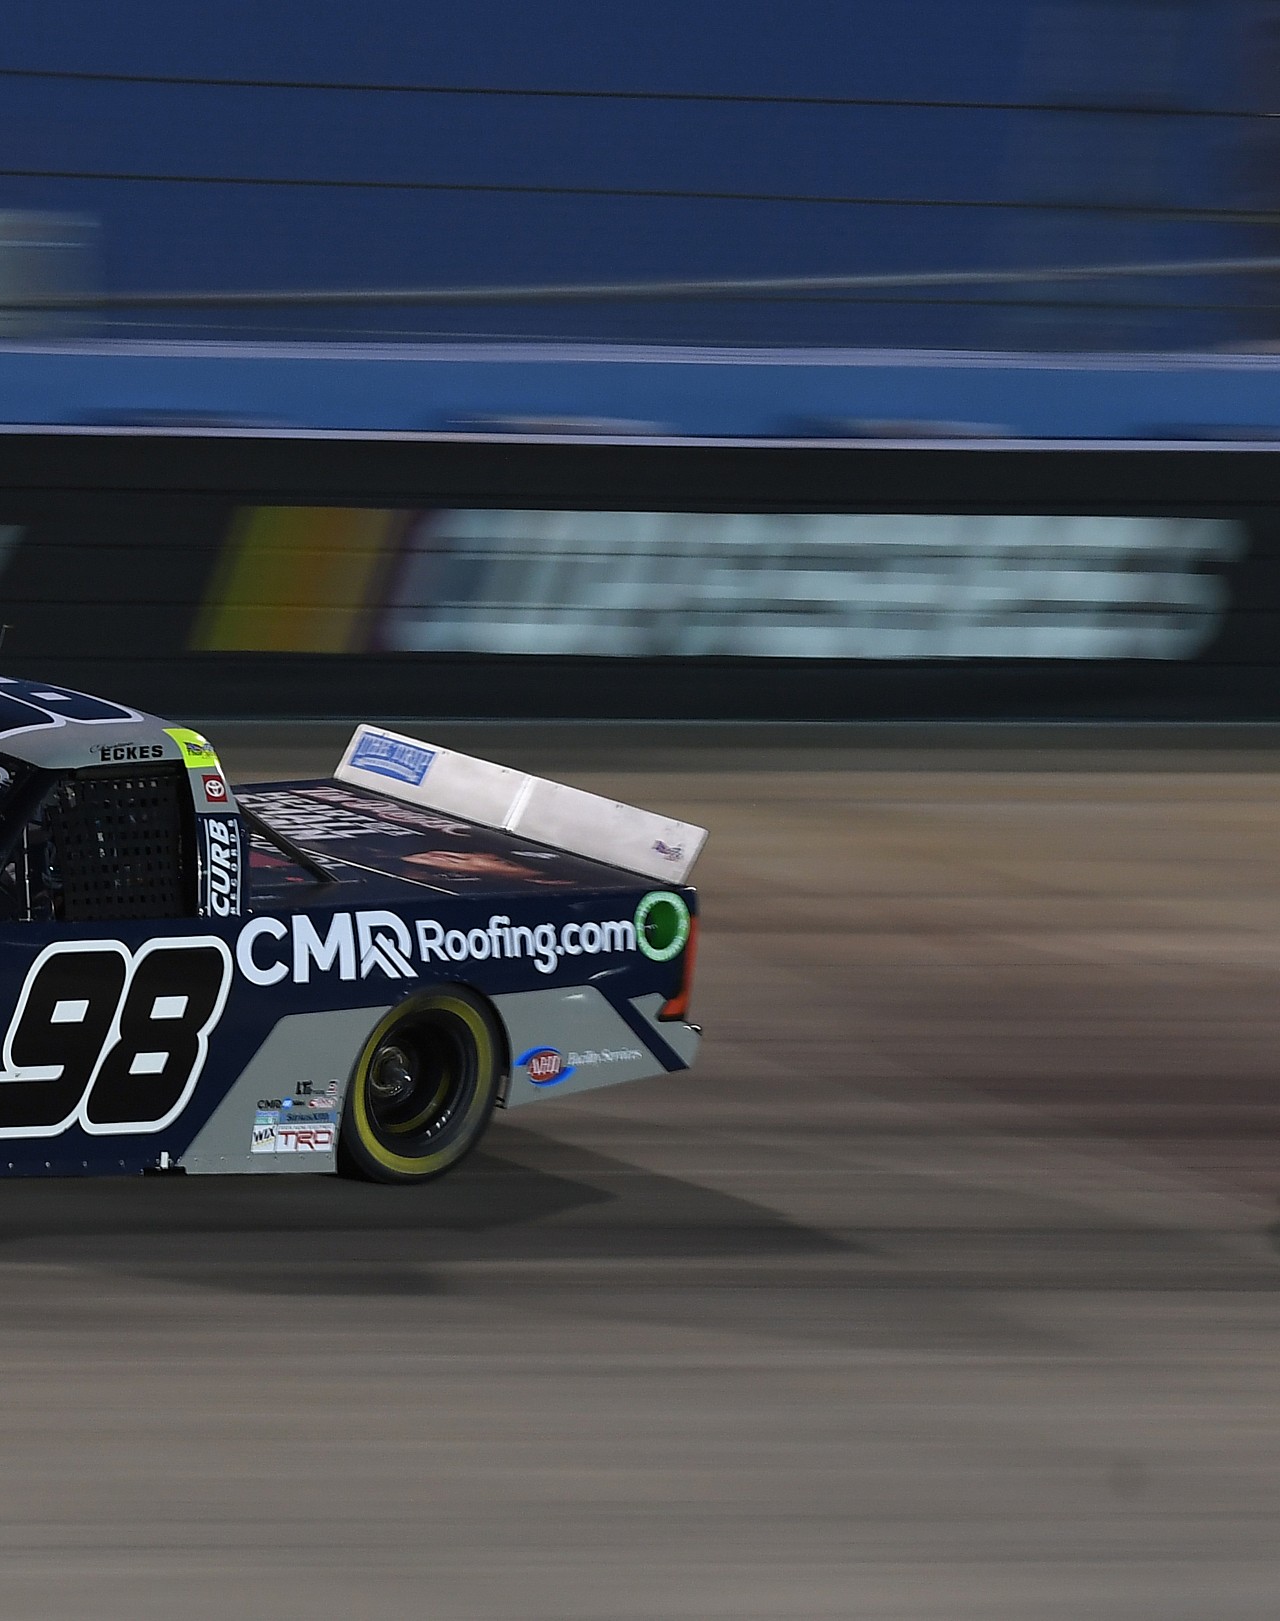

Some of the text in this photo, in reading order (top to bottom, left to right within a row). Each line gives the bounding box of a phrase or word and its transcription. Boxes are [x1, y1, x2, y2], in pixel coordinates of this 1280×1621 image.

[101, 745, 163, 762] ECKES
[208, 818, 231, 918] CURB
[236, 910, 637, 986] CMR Roofing.com
[253, 1128, 275, 1142] WIX
[278, 1130, 332, 1151] TRD
